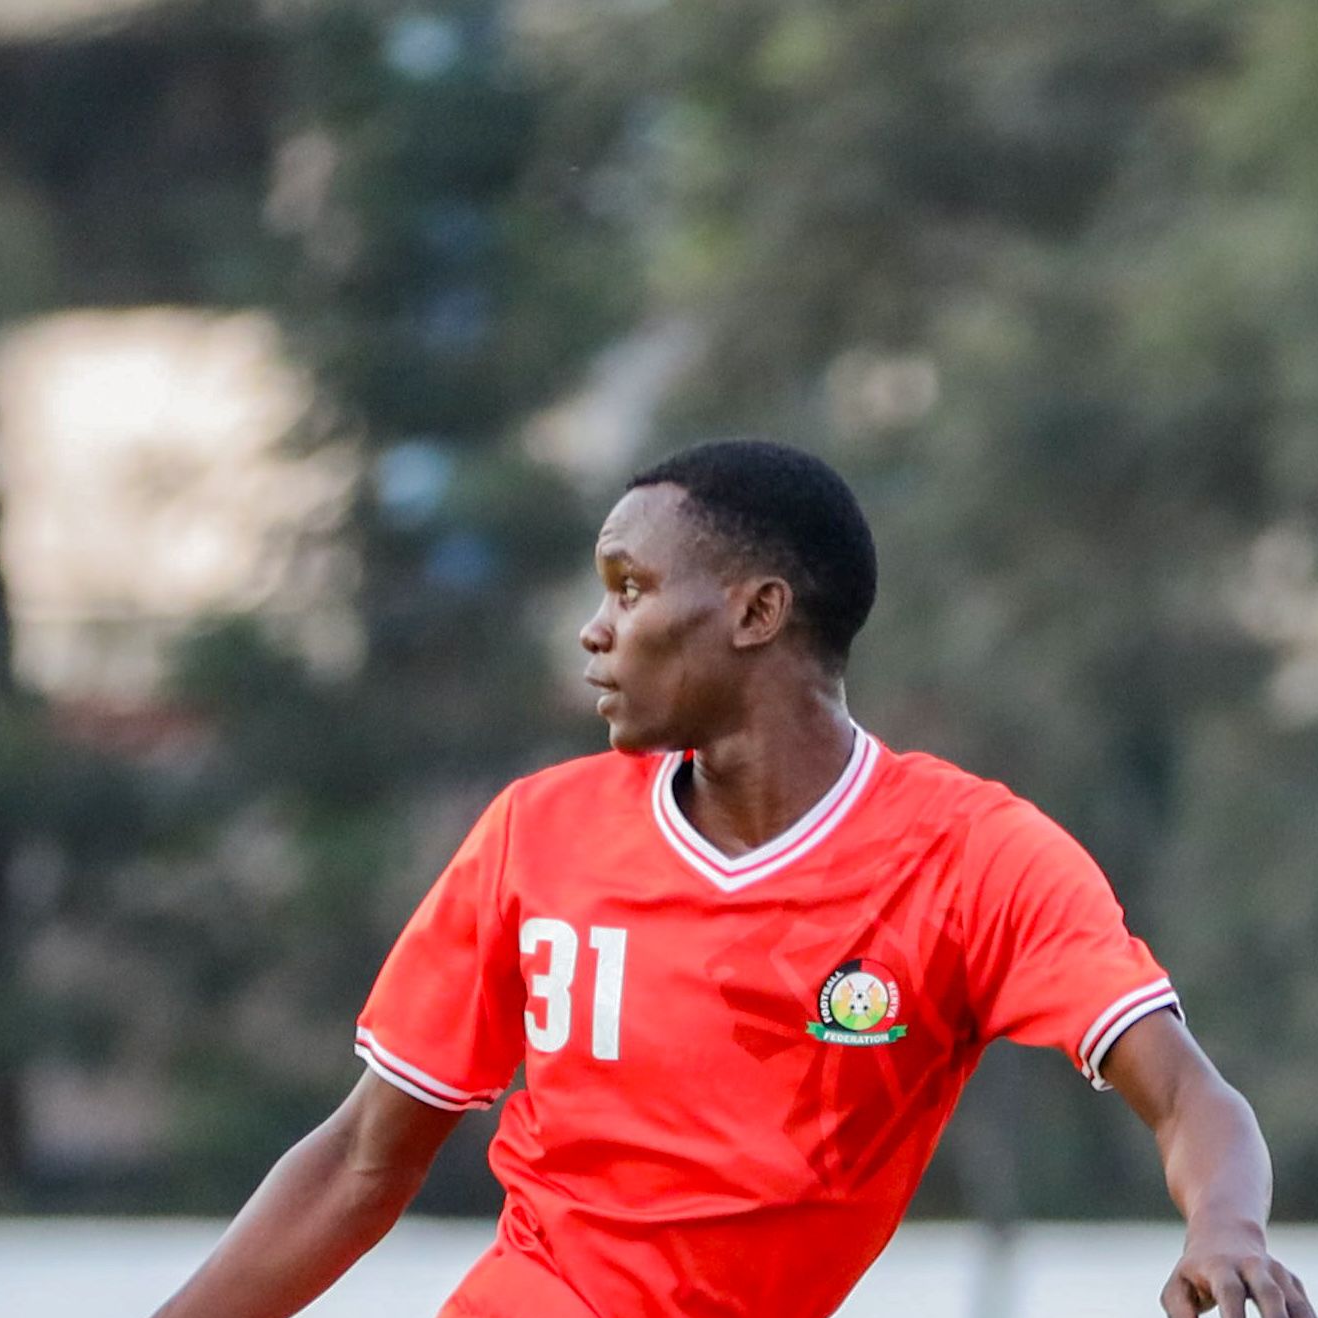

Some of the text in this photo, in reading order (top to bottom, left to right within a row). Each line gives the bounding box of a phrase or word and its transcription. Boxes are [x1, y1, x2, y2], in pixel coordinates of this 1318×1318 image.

[519, 917, 627, 1061] 31
[820, 971, 844, 1024] FOOTBALL
[886, 981, 900, 1018] KENYA
[823, 1031, 889, 1044] FEDERATION
